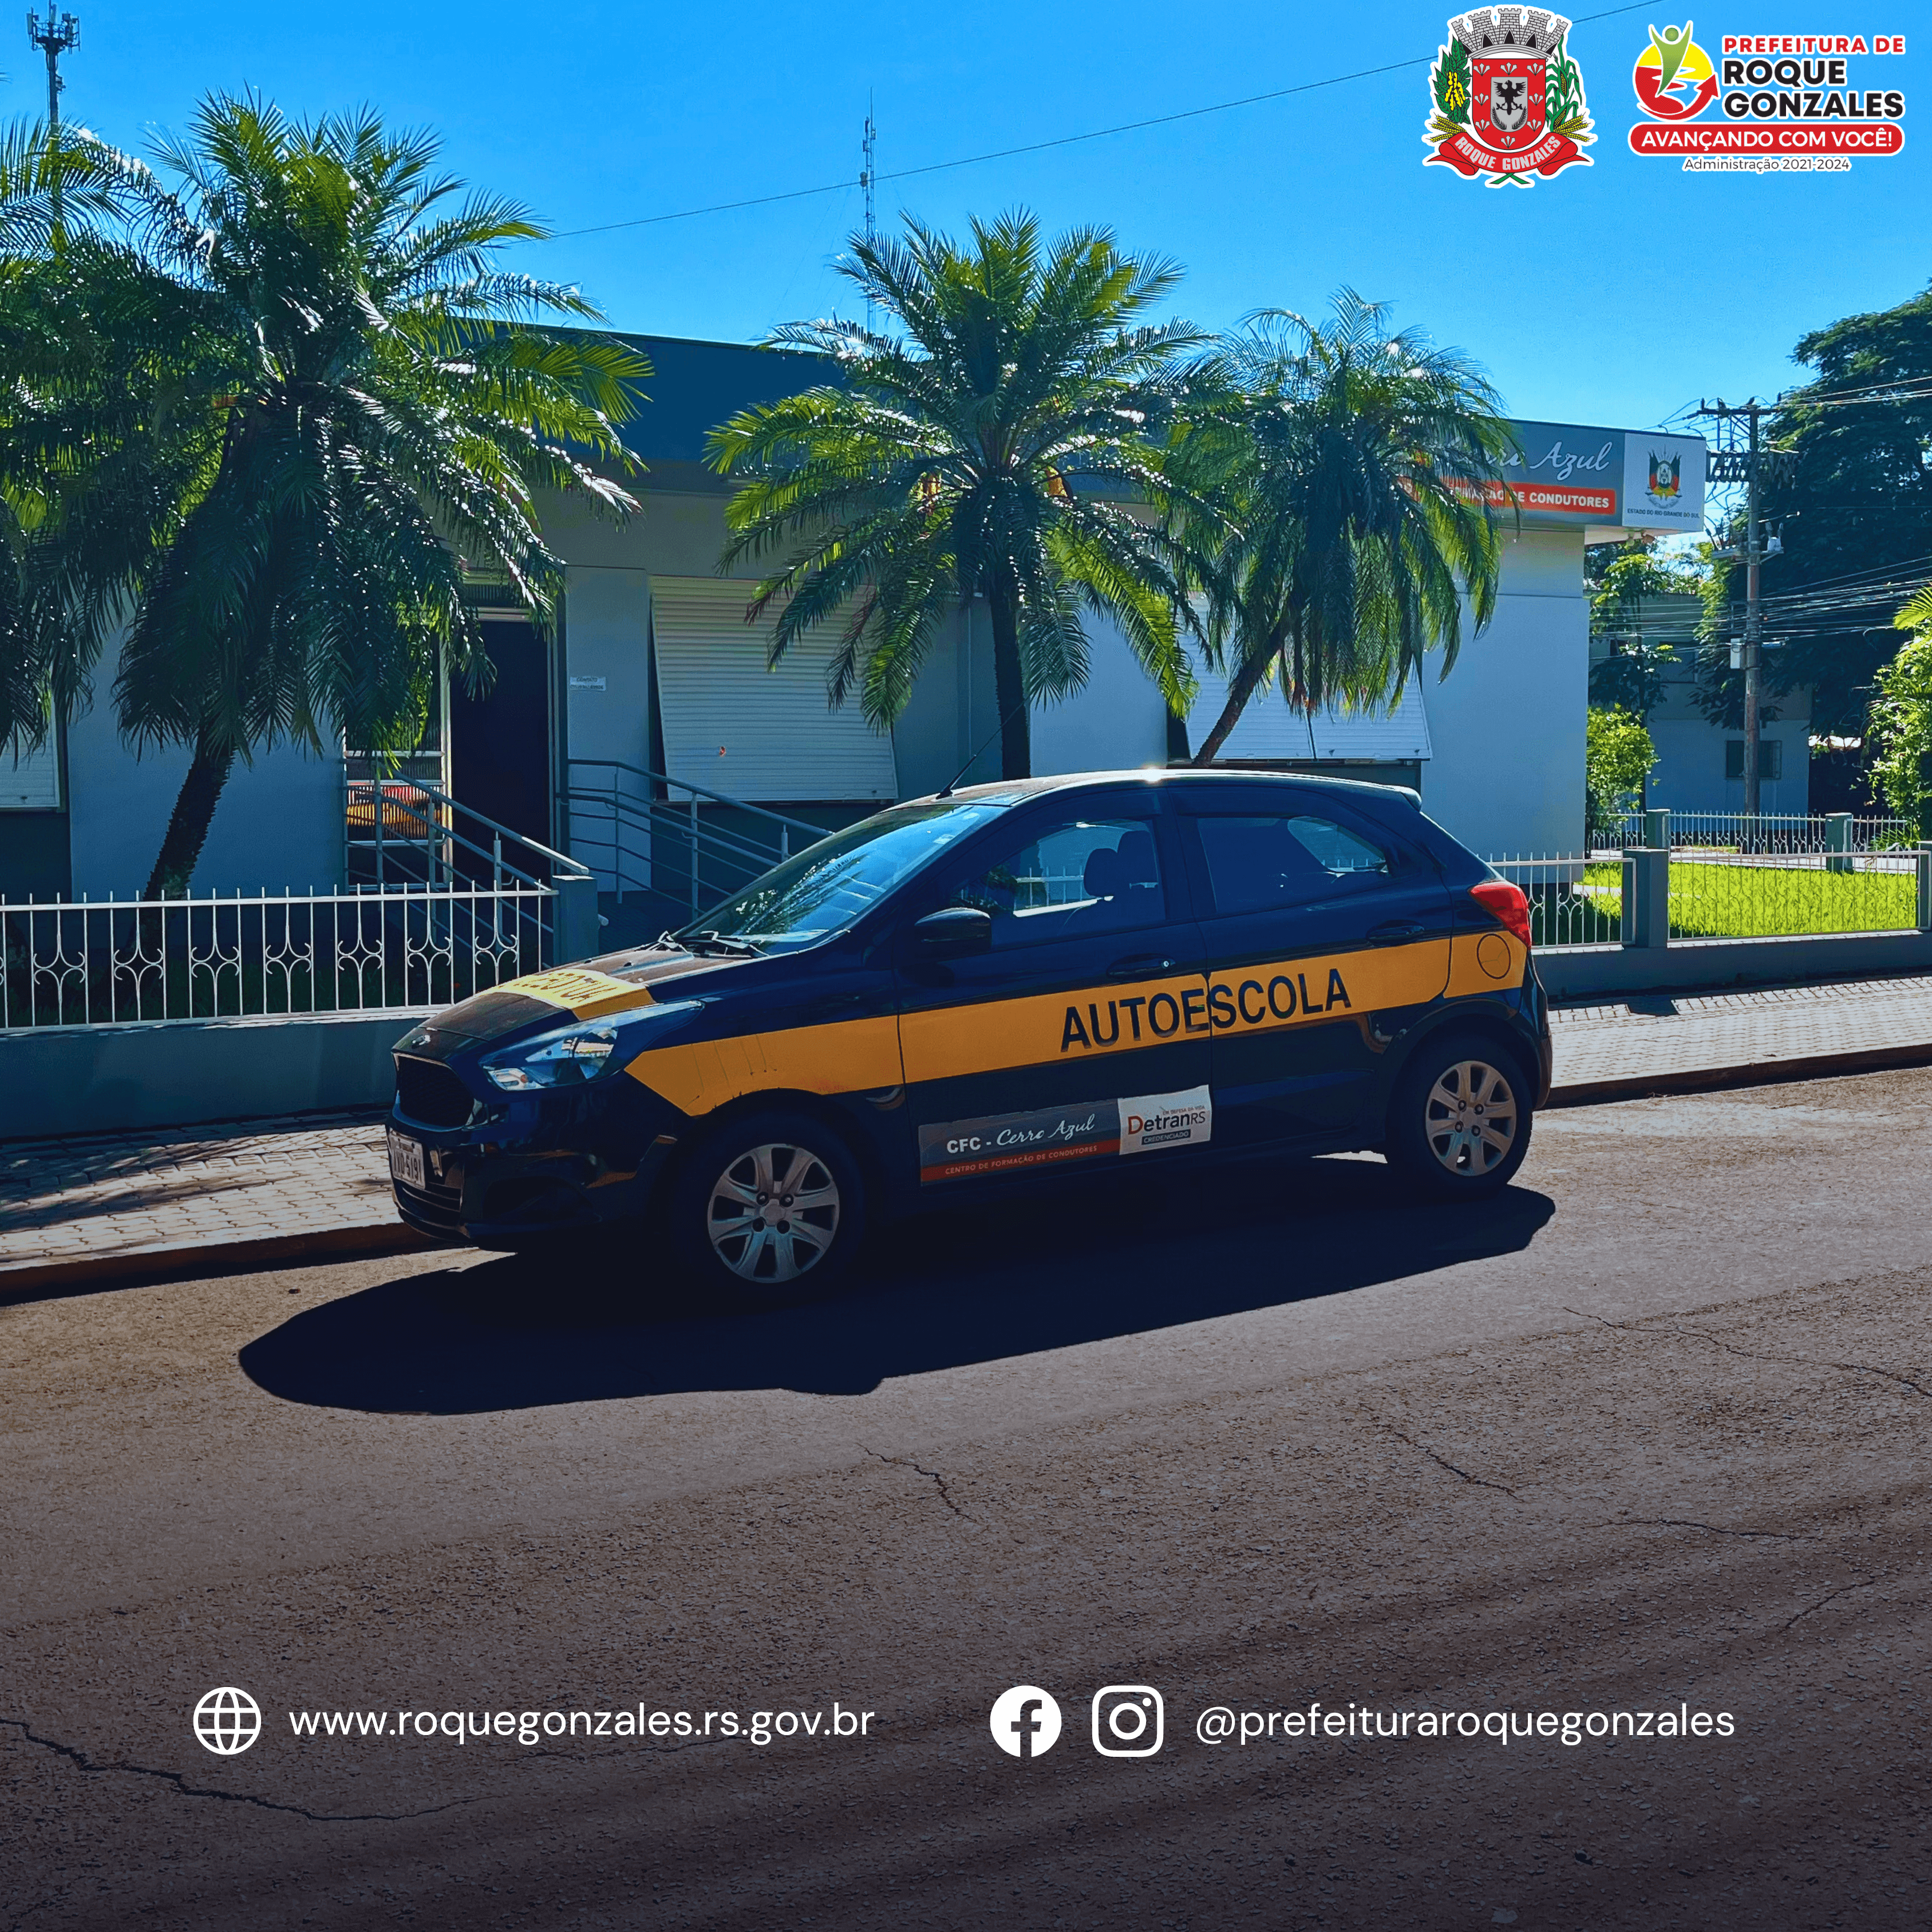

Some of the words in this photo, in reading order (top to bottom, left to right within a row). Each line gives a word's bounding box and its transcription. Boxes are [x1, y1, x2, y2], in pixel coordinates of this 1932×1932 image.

[1530, 441, 1612, 481] Azul
[1529, 492, 1609, 508] CONDUTORES
[1060, 969, 1352, 1053] AUTOESCOLA
[946, 1137, 981, 1153] CFC
[996, 1129, 1045, 1145] Cerro
[1048, 1114, 1095, 1141] Azul
[1144, 1131, 1189, 1143] CREDENCIADO
[945, 1164, 976, 1175] CENTRO
[978, 1161, 989, 1170] DE
[991, 1155, 1034, 1167] FORMAÇÃO
[1037, 1153, 1046, 1161] DE
[1048, 1145, 1097, 1159] CONDUTORES
